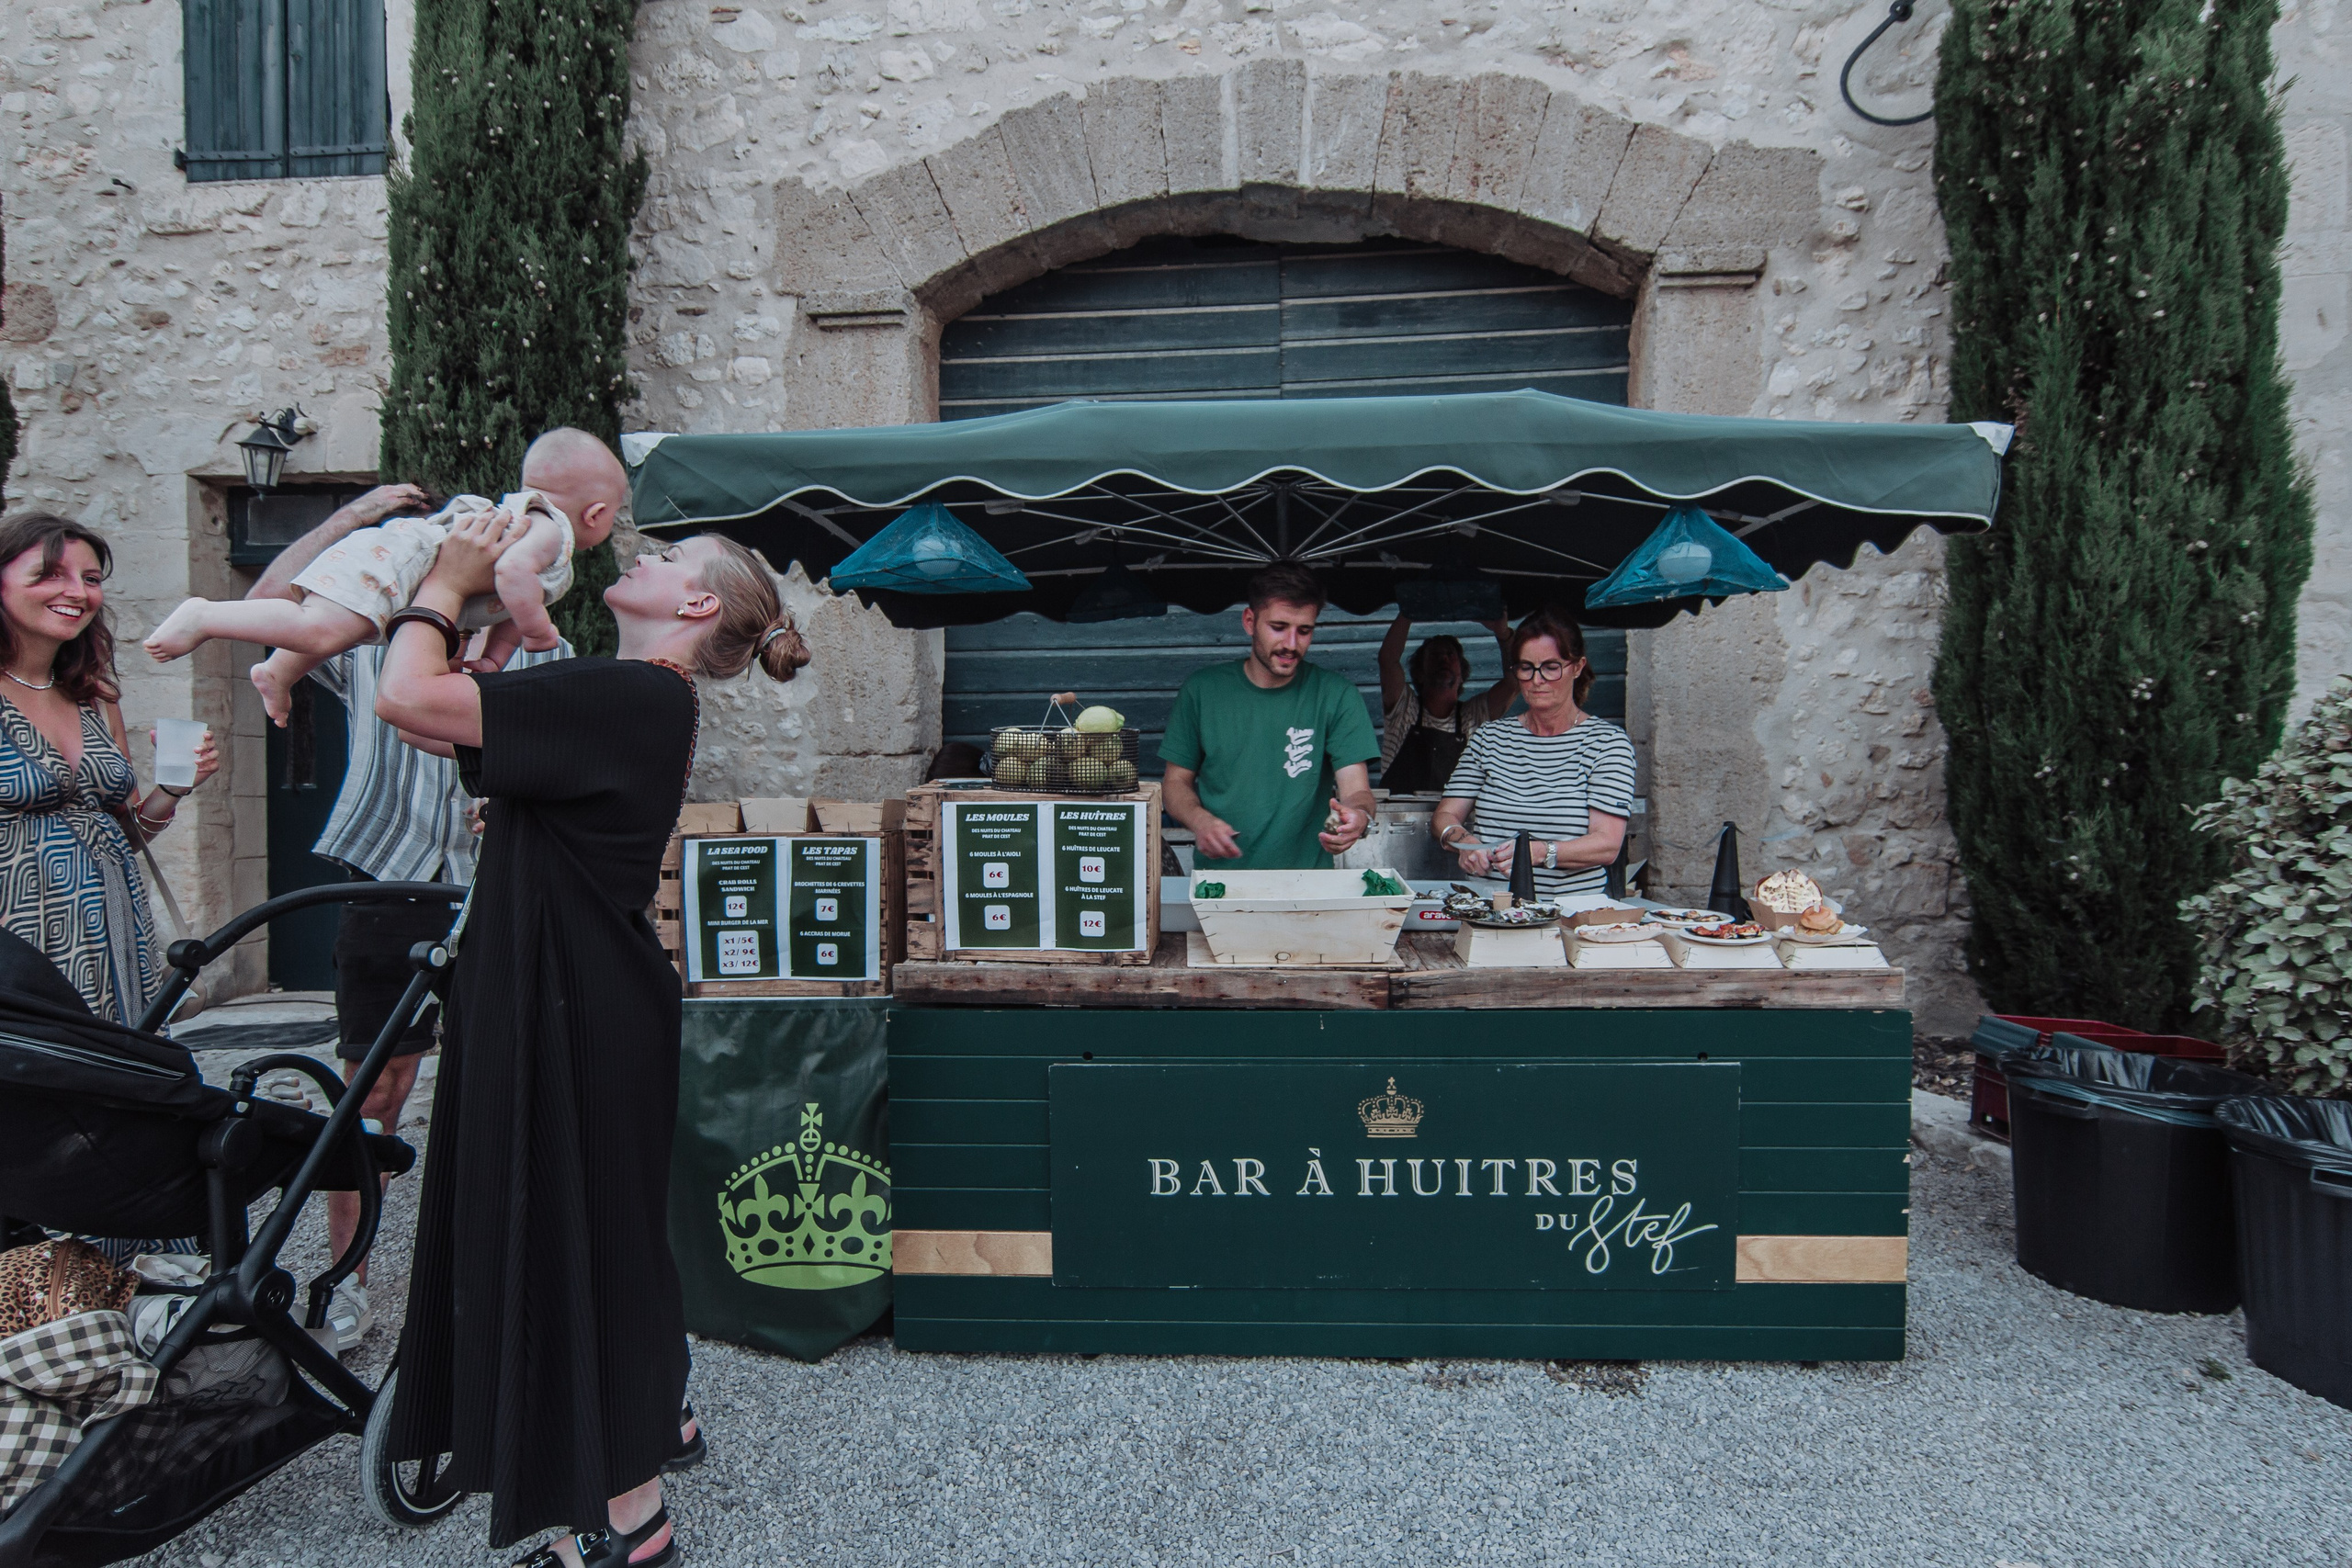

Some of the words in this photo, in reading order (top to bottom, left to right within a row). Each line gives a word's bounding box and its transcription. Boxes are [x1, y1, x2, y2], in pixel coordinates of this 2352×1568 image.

[1080, 810, 1126, 820] HUÎTRES
[741, 846, 768, 854] FOOD
[1148, 1158, 1272, 1196] BAR
[1296, 1147, 1334, 1196] À
[1355, 1158, 1638, 1196] HUITRES
[1535, 1213, 1577, 1231] DU
[1567, 1195, 1718, 1275] Stef
